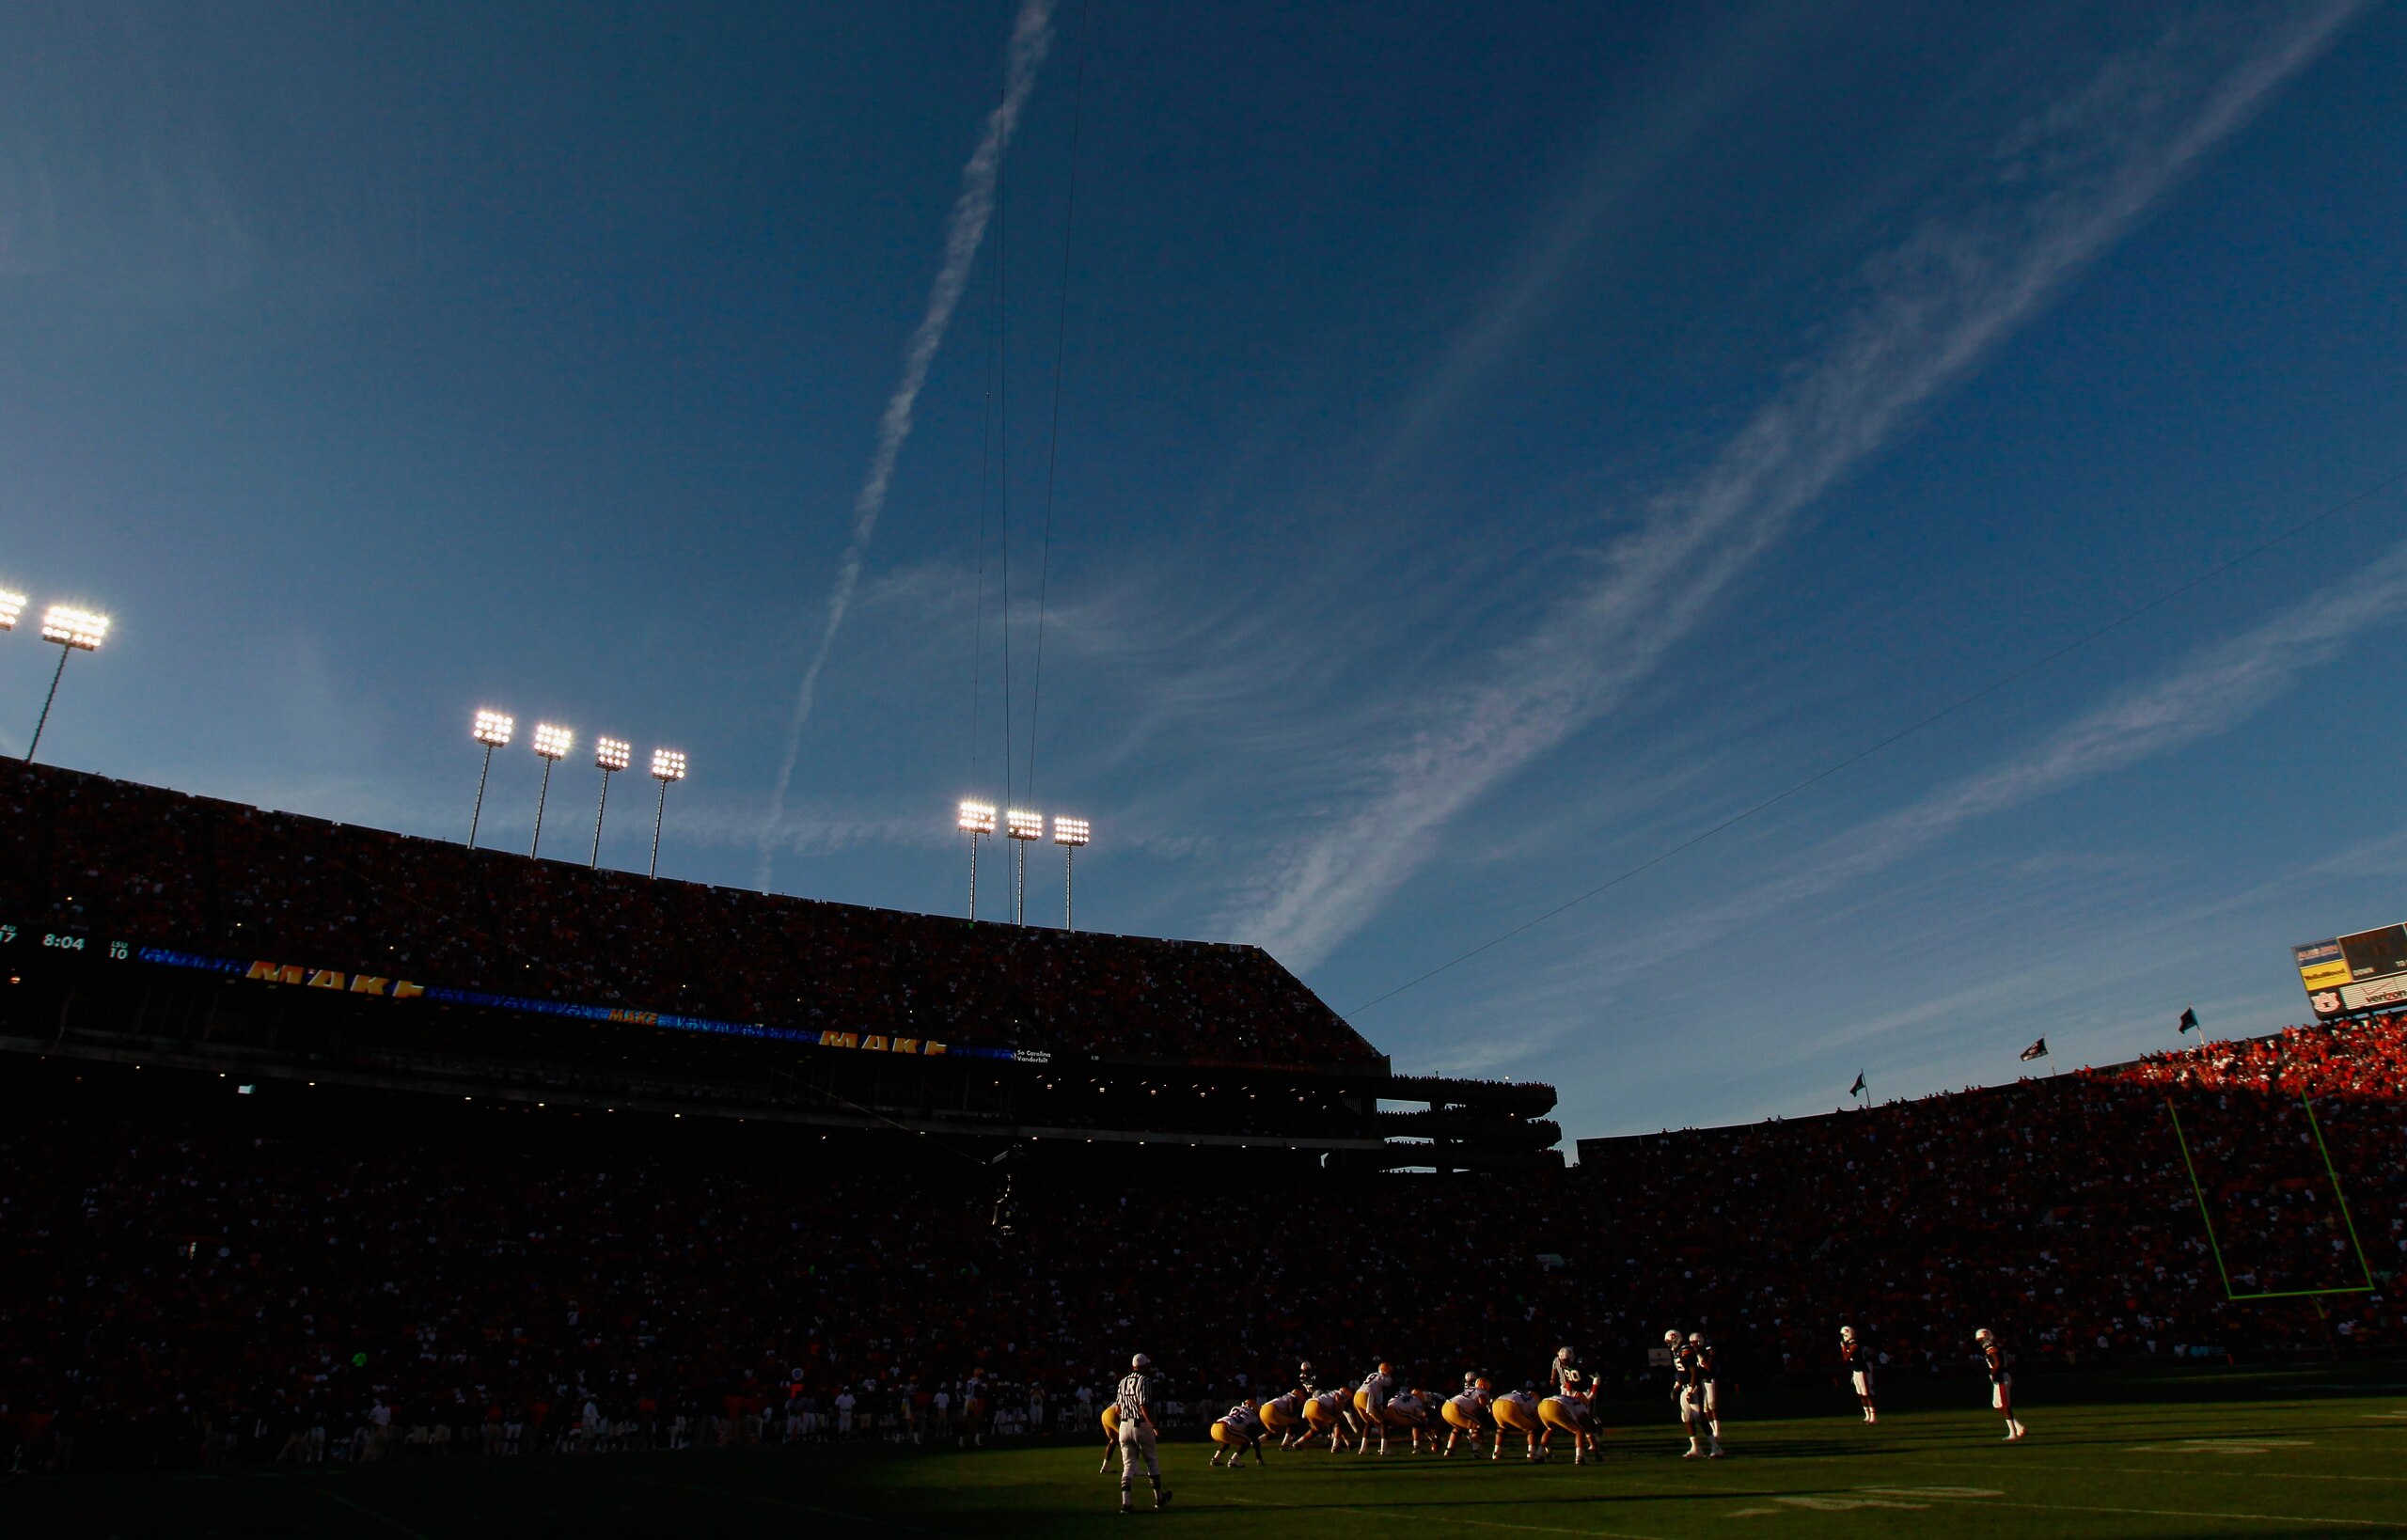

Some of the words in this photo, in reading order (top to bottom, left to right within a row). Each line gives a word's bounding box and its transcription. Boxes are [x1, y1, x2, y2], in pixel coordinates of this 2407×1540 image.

[42, 934, 86, 951] 8:04
[111, 940, 129, 949] LSU
[109, 948, 130, 960] 10
[2304, 968, 2346, 981] YellaWood
[2366, 990, 2407, 1003] verizon
[607, 1009, 659, 1028] MAKE
[1564, 1368, 1581, 1382] 90
[1125, 1376, 1137, 1396] R
